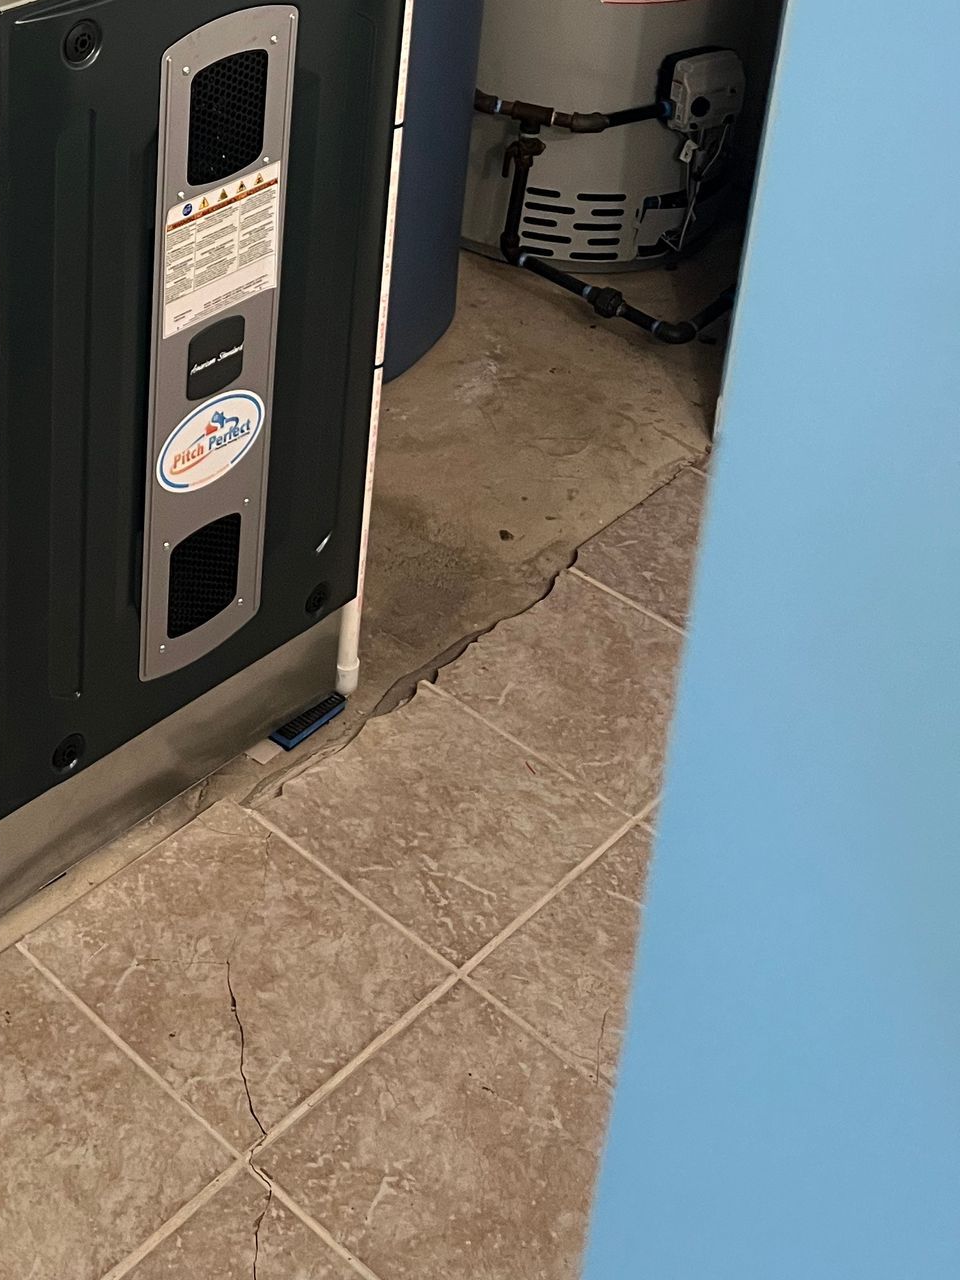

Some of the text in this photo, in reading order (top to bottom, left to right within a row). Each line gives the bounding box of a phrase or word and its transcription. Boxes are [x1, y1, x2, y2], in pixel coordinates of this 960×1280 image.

[190, 343, 245, 375] American Standard
[173, 418, 251, 468] Pitch Perfect
